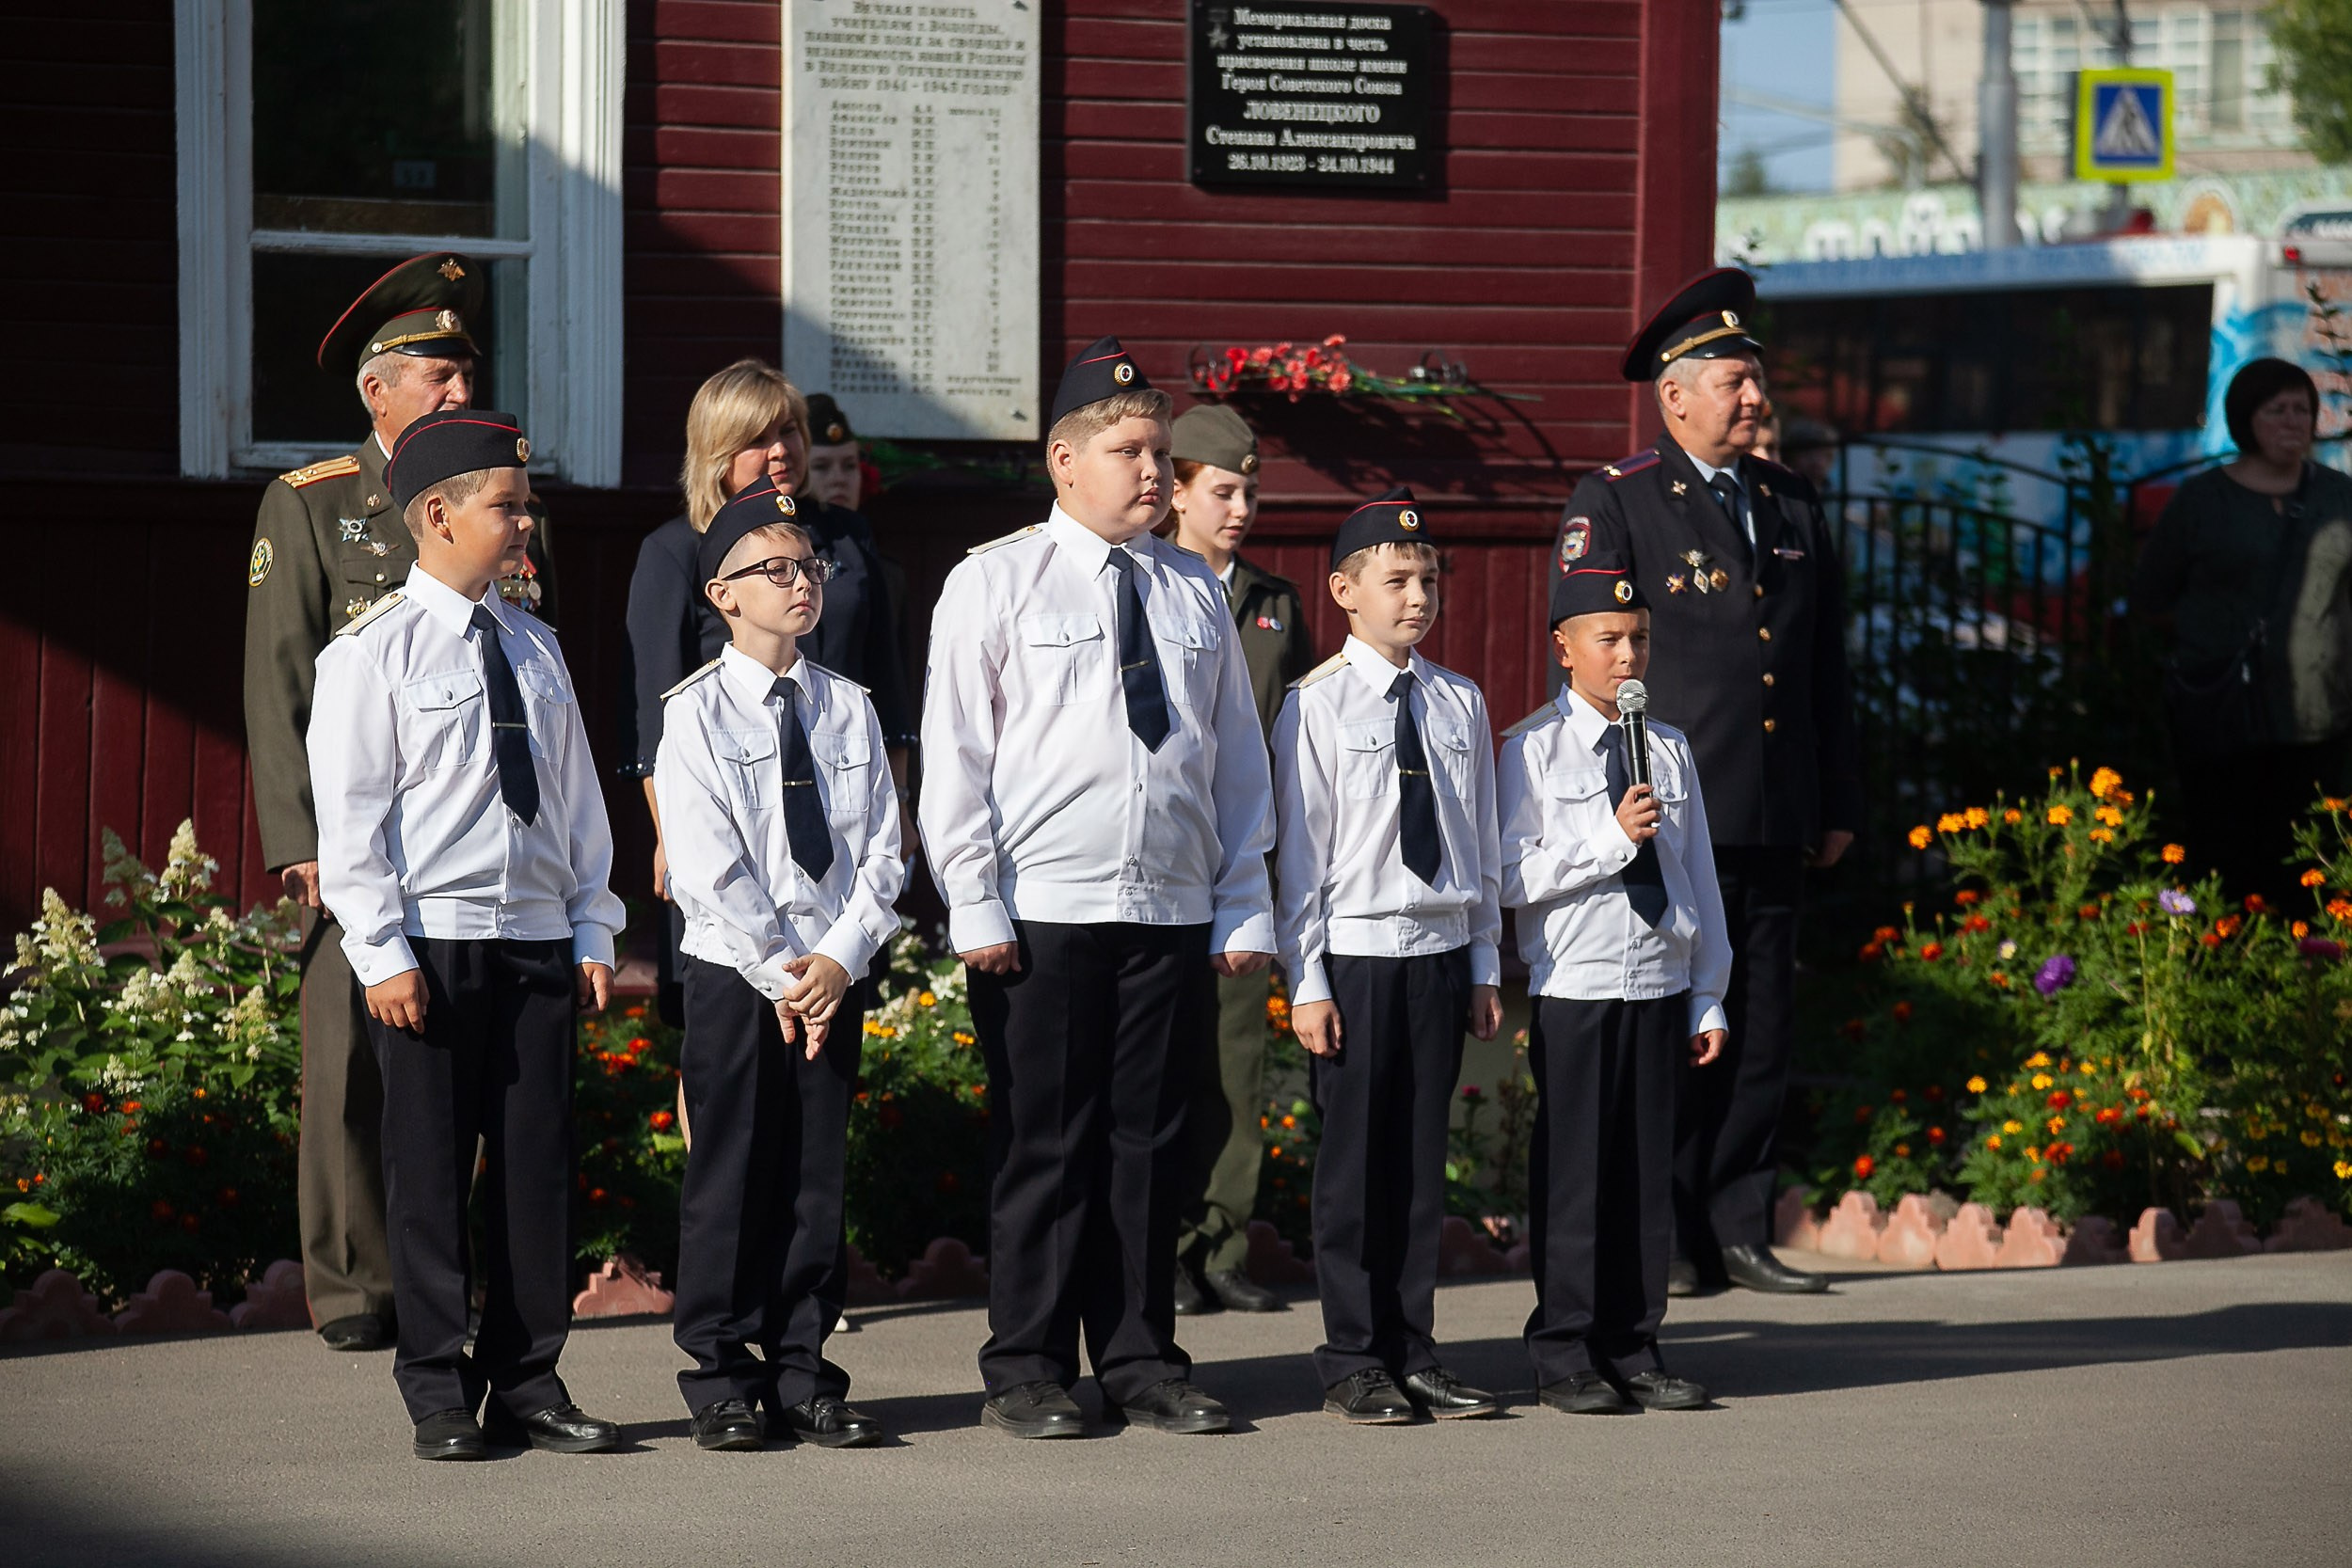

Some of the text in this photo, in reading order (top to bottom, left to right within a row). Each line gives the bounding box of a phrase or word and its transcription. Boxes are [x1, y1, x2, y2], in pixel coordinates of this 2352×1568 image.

[1233, 8, 1392, 31] Мемориальная доска
[1237, 34, 1389, 52] установлена в честь
[1216, 55, 1408, 74] присвоения школе имени
[1221, 71, 1403, 95] Героя Советского Союза
[1243, 100, 1381, 124] ЛОВЕНЕЦКОГО
[1205, 124, 1417, 152] Степана Александровича
